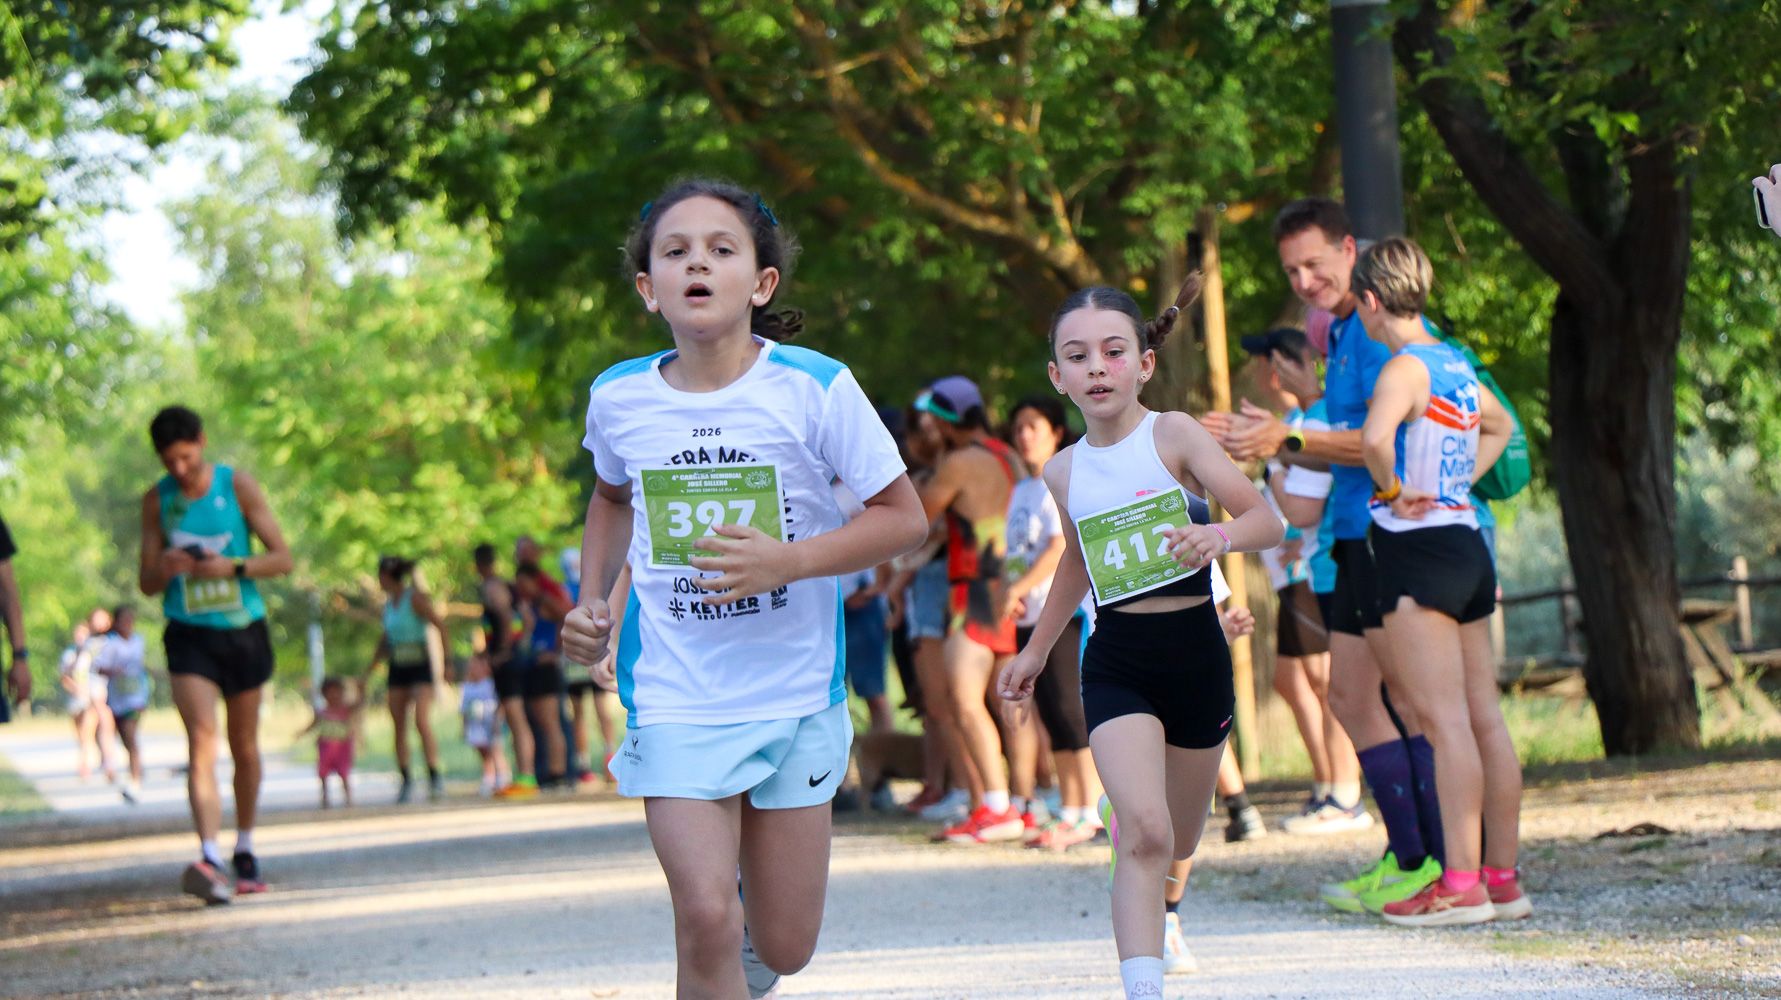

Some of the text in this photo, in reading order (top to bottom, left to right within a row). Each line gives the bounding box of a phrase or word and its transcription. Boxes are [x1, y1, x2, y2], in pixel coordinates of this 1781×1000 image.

[692, 427, 722, 438] 2026
[668, 499, 756, 538] 397
[1103, 522, 1179, 571] 412
